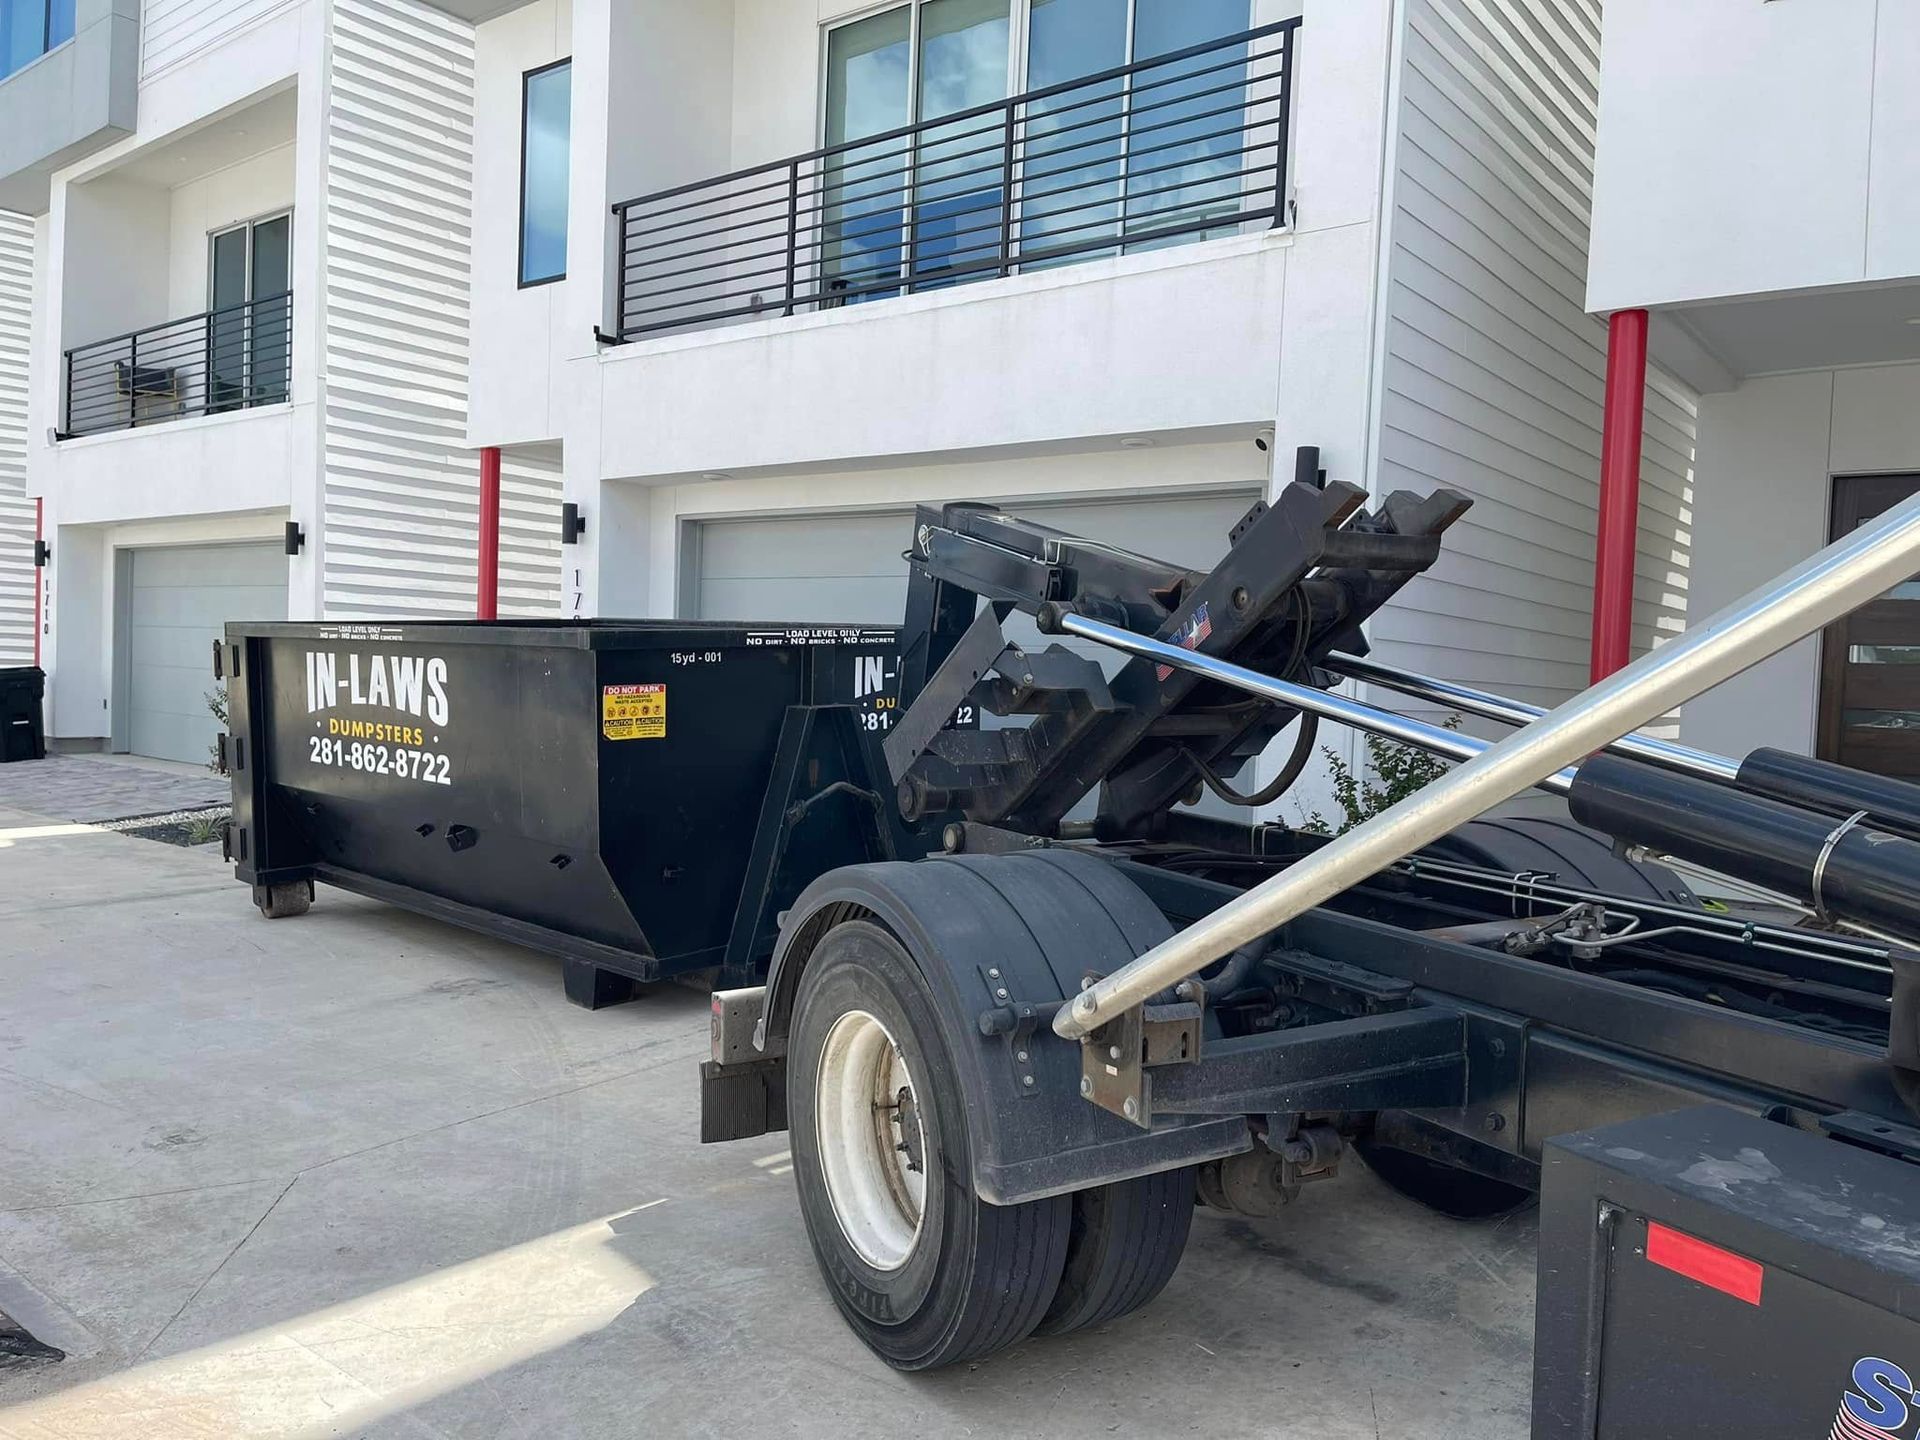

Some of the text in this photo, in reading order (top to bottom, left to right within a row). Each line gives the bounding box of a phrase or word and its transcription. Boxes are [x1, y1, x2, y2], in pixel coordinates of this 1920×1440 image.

[746, 637, 762, 645] NO
[790, 637, 806, 645] NO
[843, 636, 858, 644] NO
[785, 629, 861, 638] LOAD LEVEL ONLY
[670, 651, 696, 666] 15yd
[704, 651, 722, 663] 001
[854, 655, 901, 699] IN-
[306, 651, 449, 727] IN-LAWS
[608, 685, 660, 695] DO NOT PARK
[876, 697, 896, 709] DU
[329, 718, 424, 746] DUMPSTERS
[309, 736, 452, 786] 281-862-8722
